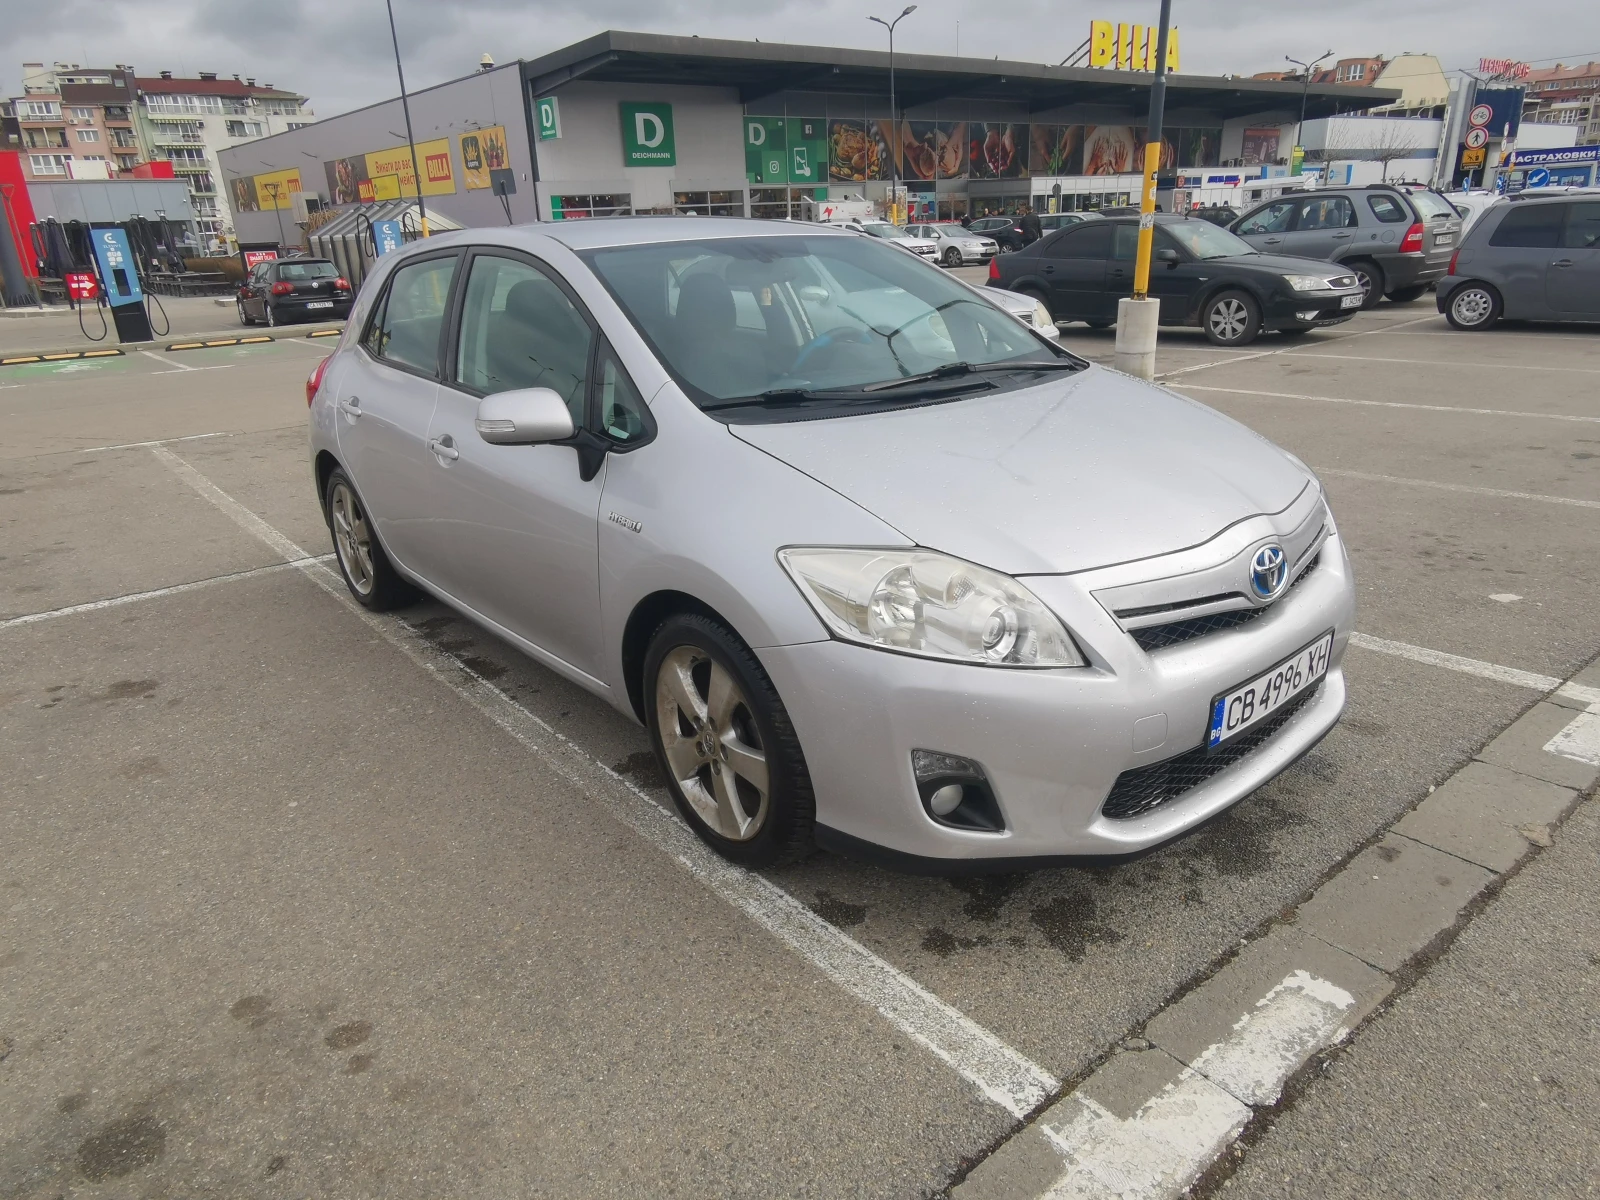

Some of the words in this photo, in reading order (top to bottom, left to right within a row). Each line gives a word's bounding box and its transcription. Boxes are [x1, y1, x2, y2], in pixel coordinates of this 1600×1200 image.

[1089, 20, 1180, 72] BILLA
[541, 104, 553, 128] D
[635, 112, 665, 148] D
[1513, 150, 1597, 163] АСТРАХОВКИ
[427, 158, 449, 178] BILLA
[359, 183, 374, 199] BILLA
[609, 511, 637, 531] HYBRID
[1210, 726, 1221, 740] BG
[1226, 688, 1256, 731] CB
[1259, 656, 1303, 711] 4996
[1305, 638, 1330, 683] XH
